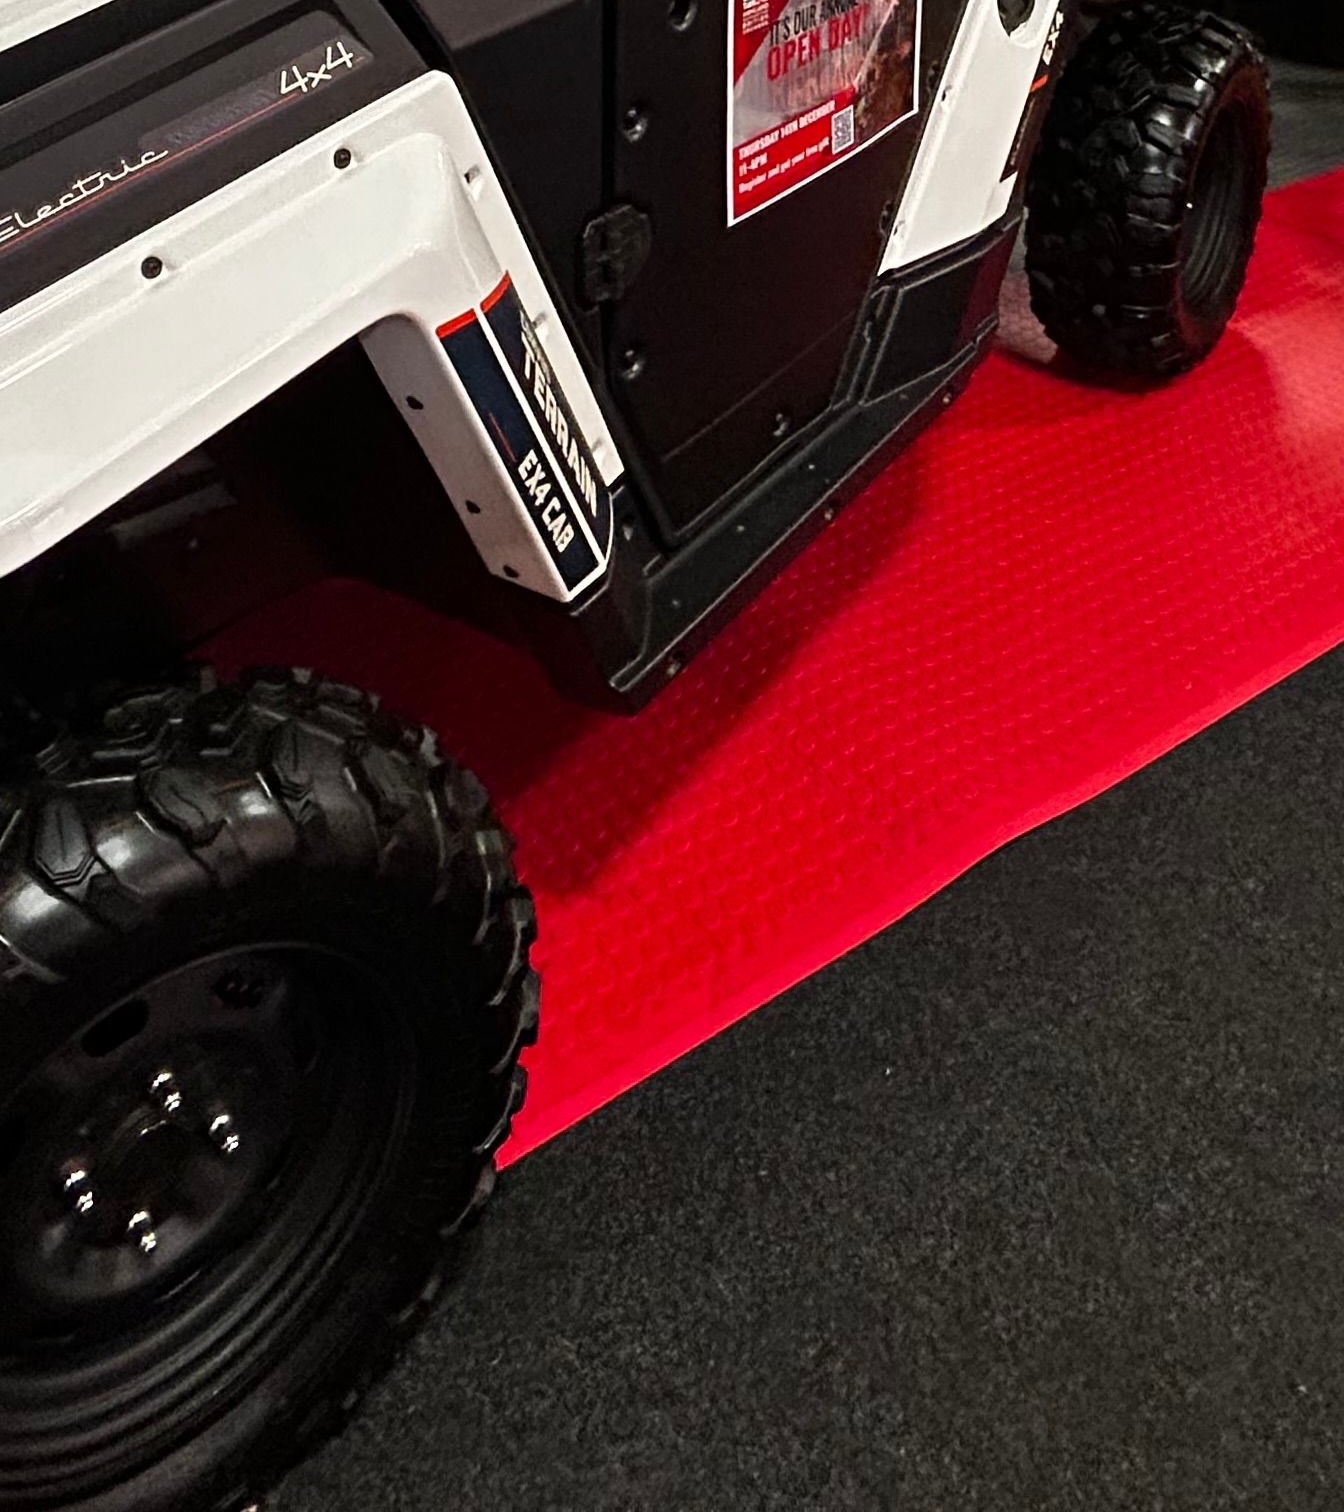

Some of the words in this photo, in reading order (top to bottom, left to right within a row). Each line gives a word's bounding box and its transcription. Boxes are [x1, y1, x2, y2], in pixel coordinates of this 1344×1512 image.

[766, 27, 823, 81] OPEN
[827, 2, 869, 52] DAY
[793, 4, 817, 35] OUR
[279, 40, 355, 95] 4x4
[738, 130, 780, 161] THURSDAY
[520, 330, 598, 518] TERRAIN
[517, 448, 552, 507] EX4
[541, 496, 576, 554] CAB
